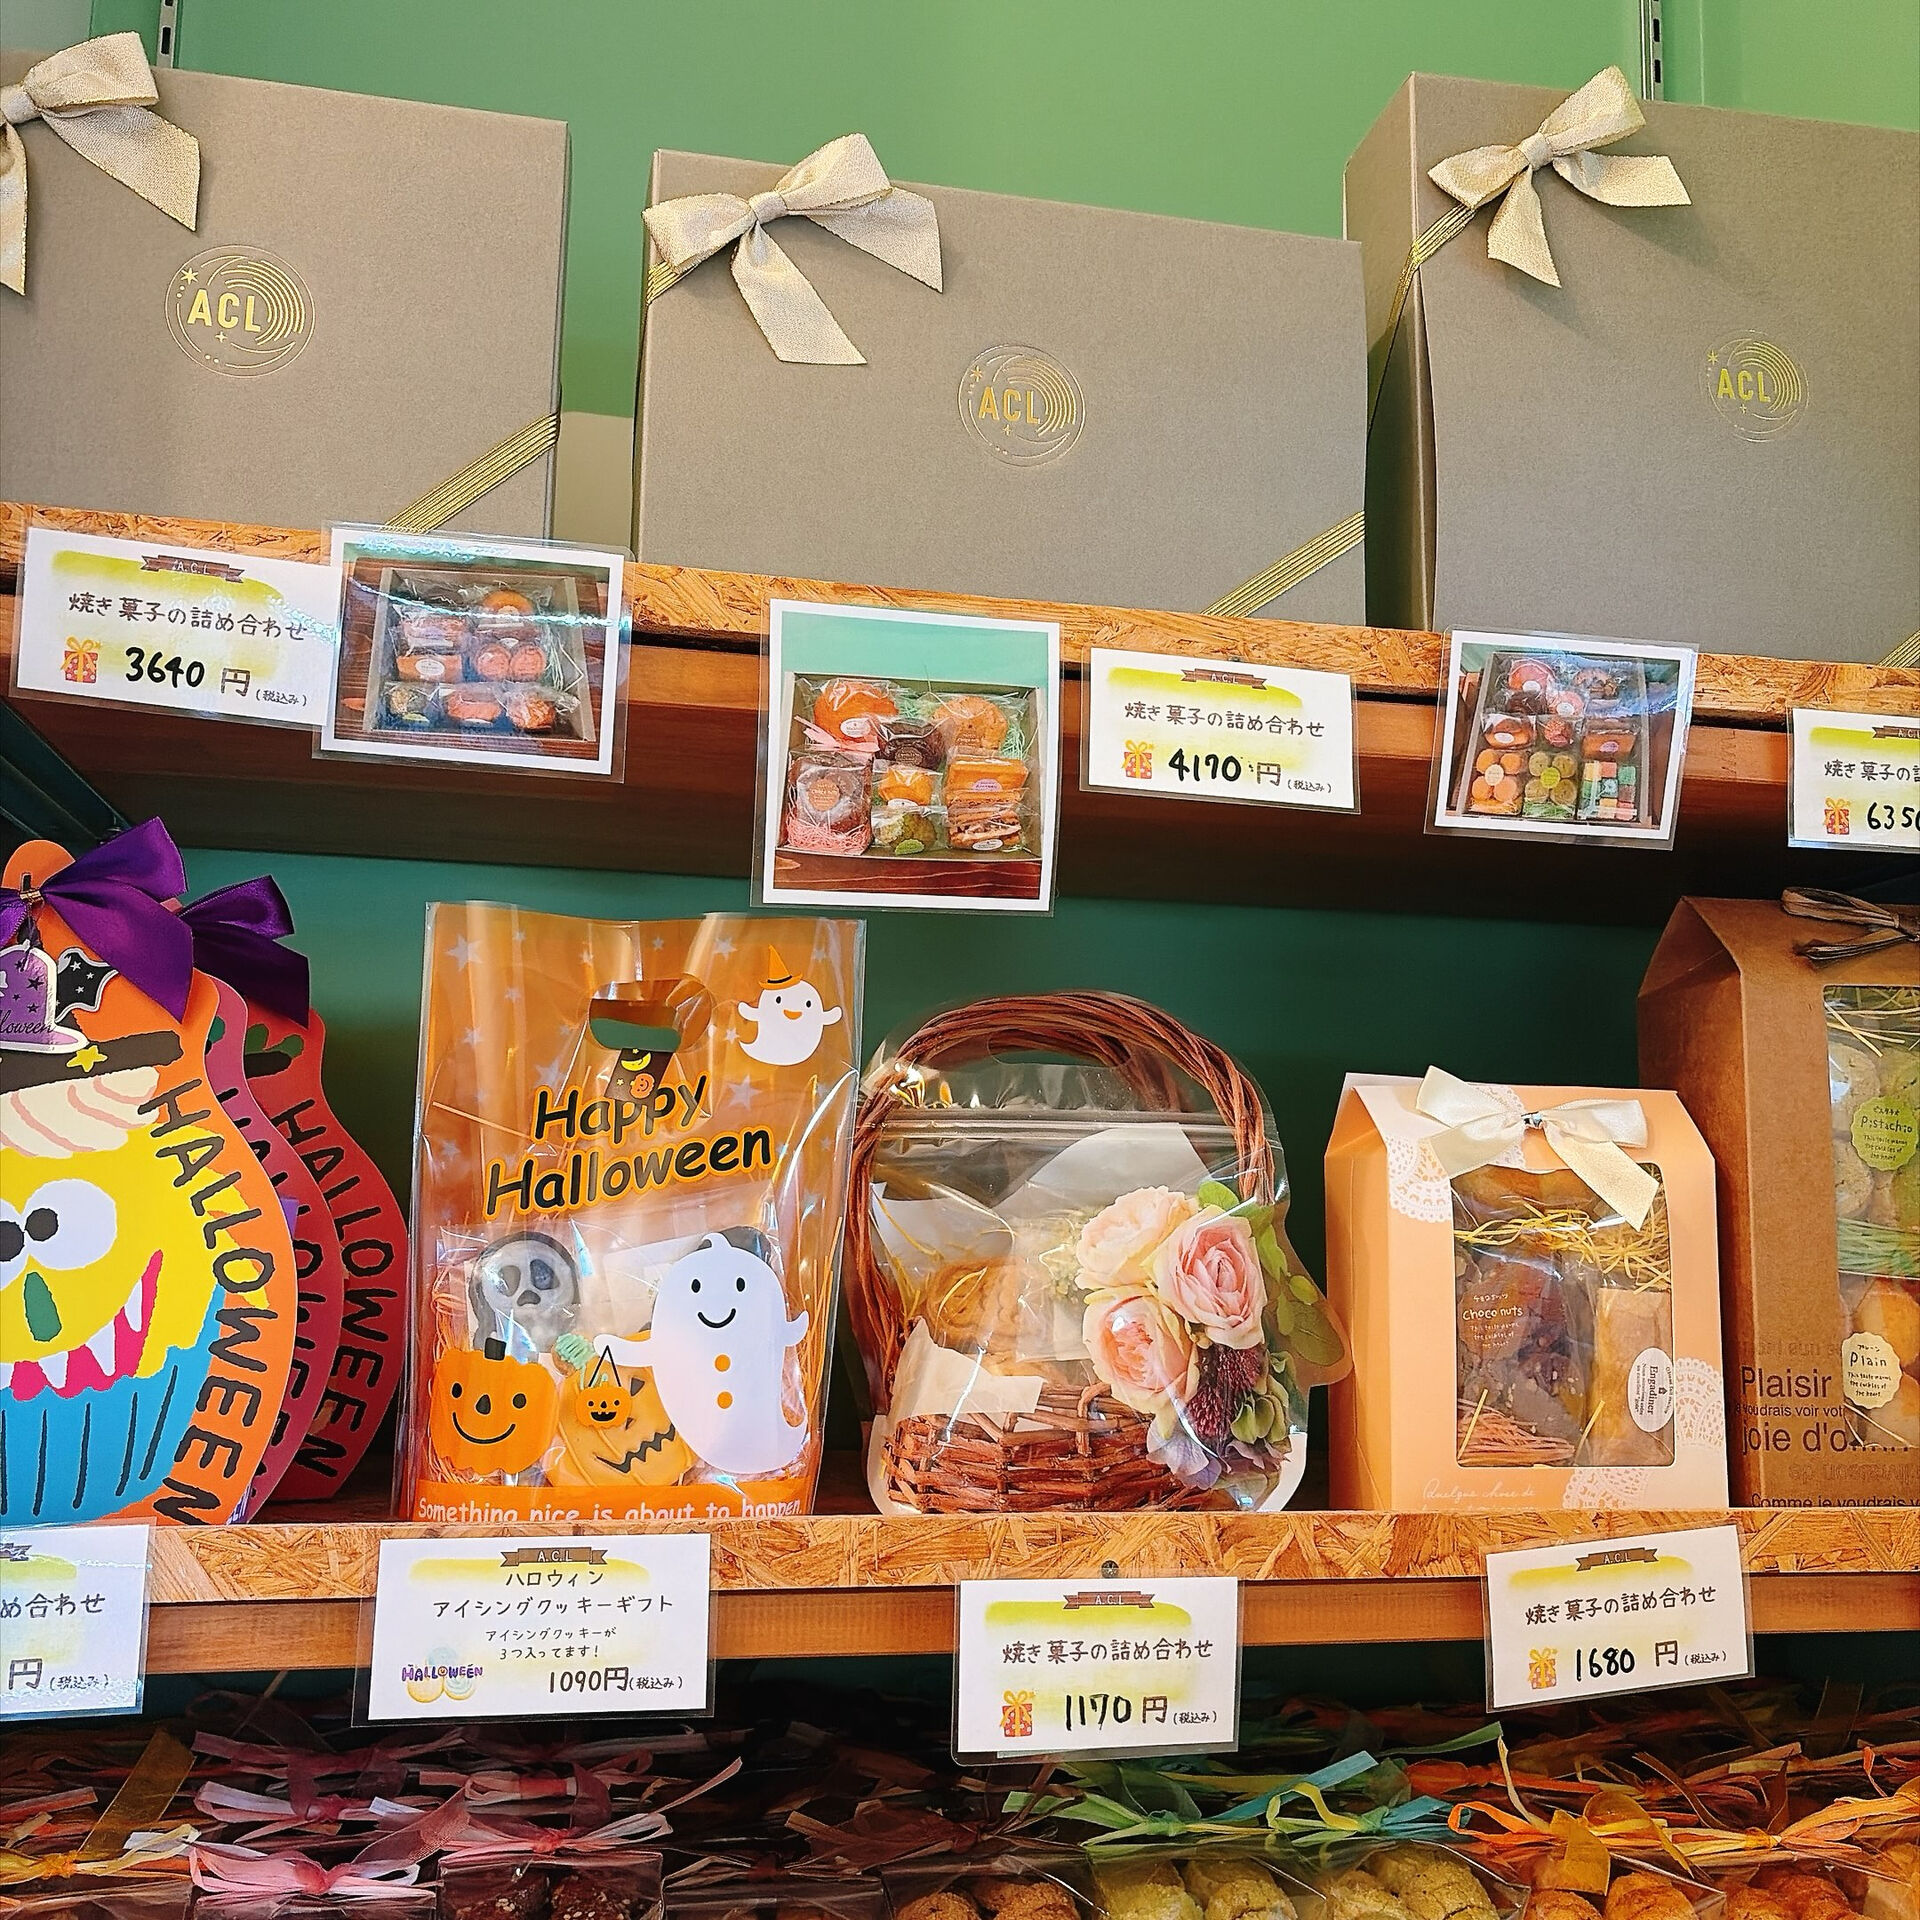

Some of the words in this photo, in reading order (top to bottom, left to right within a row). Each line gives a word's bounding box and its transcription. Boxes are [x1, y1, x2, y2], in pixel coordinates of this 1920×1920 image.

[187, 288, 263, 333] ACL
[1717, 368, 1771, 402] ACL
[978, 386, 1041, 425] ACL
[68, 591, 308, 641] 焼き菓子の詰め合わせ
[124, 646, 205, 689] 3640
[220, 666, 251, 697] 円
[1124, 701, 1325, 738] 焼き菓子の詰め合わせ
[1168, 748, 1242, 783] 4170
[1256, 761, 1282, 787] 円
[535, 1075, 708, 1142] Happy
[1861, 1115, 1913, 1133] Pistachio
[486, 1126, 773, 1216] Halloween
[137, 1078, 278, 1525] HALLOWEEN
[1500, 1305, 1524, 1316] nuts
[1850, 1351, 1887, 1367] Plain
[1647, 1365, 1659, 1416] Engadiner
[1741, 1365, 1832, 1398] Plaisir
[1743, 1403, 1792, 1417] voudrais
[1795, 1404, 1819, 1417] voir
[1743, 1418, 1791, 1456] joie
[530, 1503, 580, 1522] nice
[593, 1503, 614, 1521] is
[625, 1501, 695, 1520] about
[706, 1501, 731, 1519] to
[1751, 1492, 1813, 1507] Comme
[1837, 1494, 1906, 1507] voudrais
[505, 1568, 604, 1587] ハロウィン
[432, 1593, 674, 1618] アイシングクッキーギフト
[1525, 1585, 1717, 1626] 焼き菓子の詰め合わせ
[485, 1626, 617, 1642] アイシングクッキーが
[1002, 1637, 1213, 1665] 焼き菓子の詰め合わせ
[8, 1657, 43, 1690] 円
[401, 1663, 483, 1682] HALLOWEEN
[1575, 1647, 1636, 1682] 1680
[1654, 1640, 1679, 1667] 円
[1065, 1693, 1132, 1731] 1170
[1141, 1695, 1168, 1724] 円
